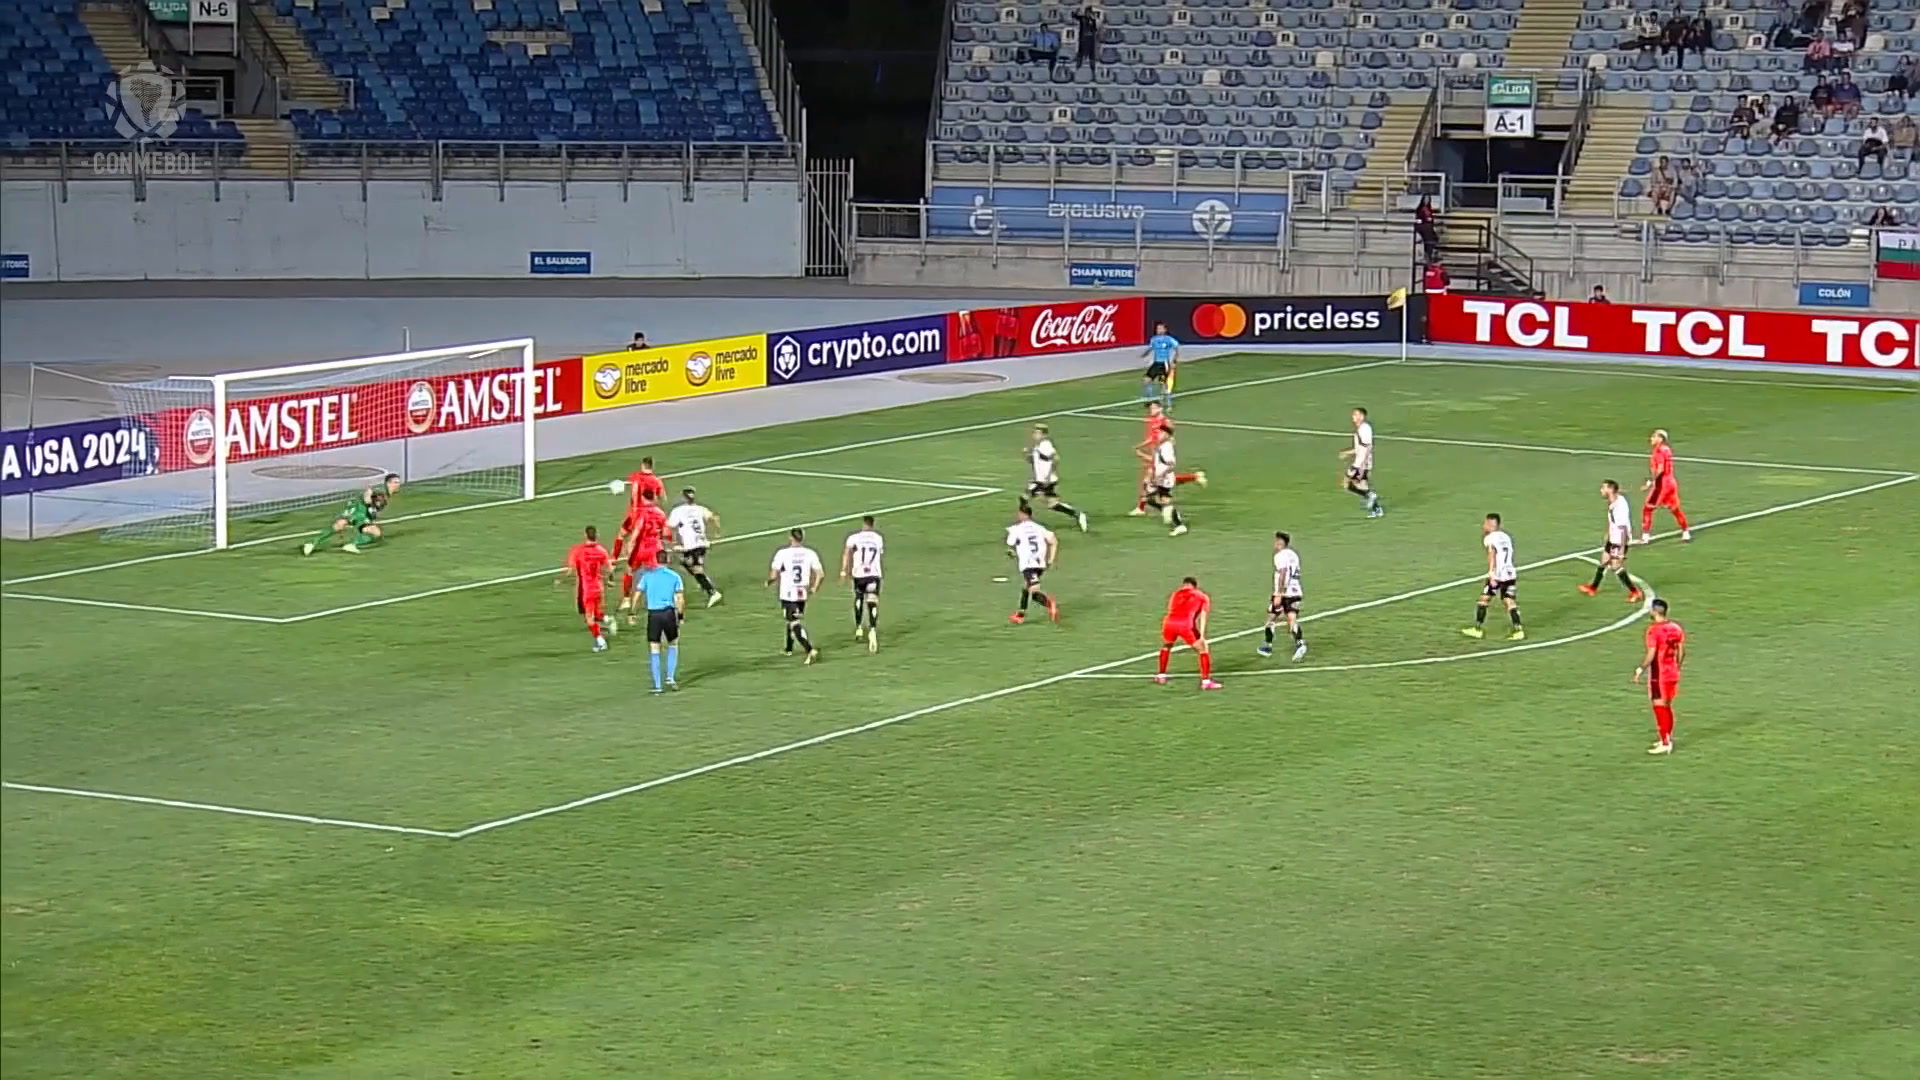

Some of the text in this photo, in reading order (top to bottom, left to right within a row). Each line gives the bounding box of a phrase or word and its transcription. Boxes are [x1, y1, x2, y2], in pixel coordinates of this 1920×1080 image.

[199, 1, 229, 17] N-6
[1491, 83, 1530, 95] SALIDA
[1494, 113, 1524, 131] A-1
[1048, 203, 1144, 219] EXCLUSIVO
[534, 256, 587, 265] EL SALVADOR
[1071, 267, 1134, 278] CHAPA VERDE
[1818, 287, 1852, 299] COLÓN
[1031, 304, 1118, 348] Coca-Cola
[1255, 305, 1380, 336] priceless
[1463, 300, 1588, 348] TCL
[1632, 309, 1765, 358] TCL
[808, 326, 941, 369] crypto.com
[1811, 318, 1920, 368] TC
[715, 346, 758, 367] mercado
[625, 360, 669, 377] mercado
[715, 364, 735, 382] livre
[625, 377, 647, 395] libre
[437, 367, 562, 428] AMSTEL
[225, 393, 359, 457] AMSTEL
[26, 436, 79, 477] USA
[82, 428, 146, 469] 2024
[1028, 535, 1039, 553] 5
[861, 546, 877, 565] 17
[1502, 547, 1509, 563] 7
[792, 564, 803, 584] 3
